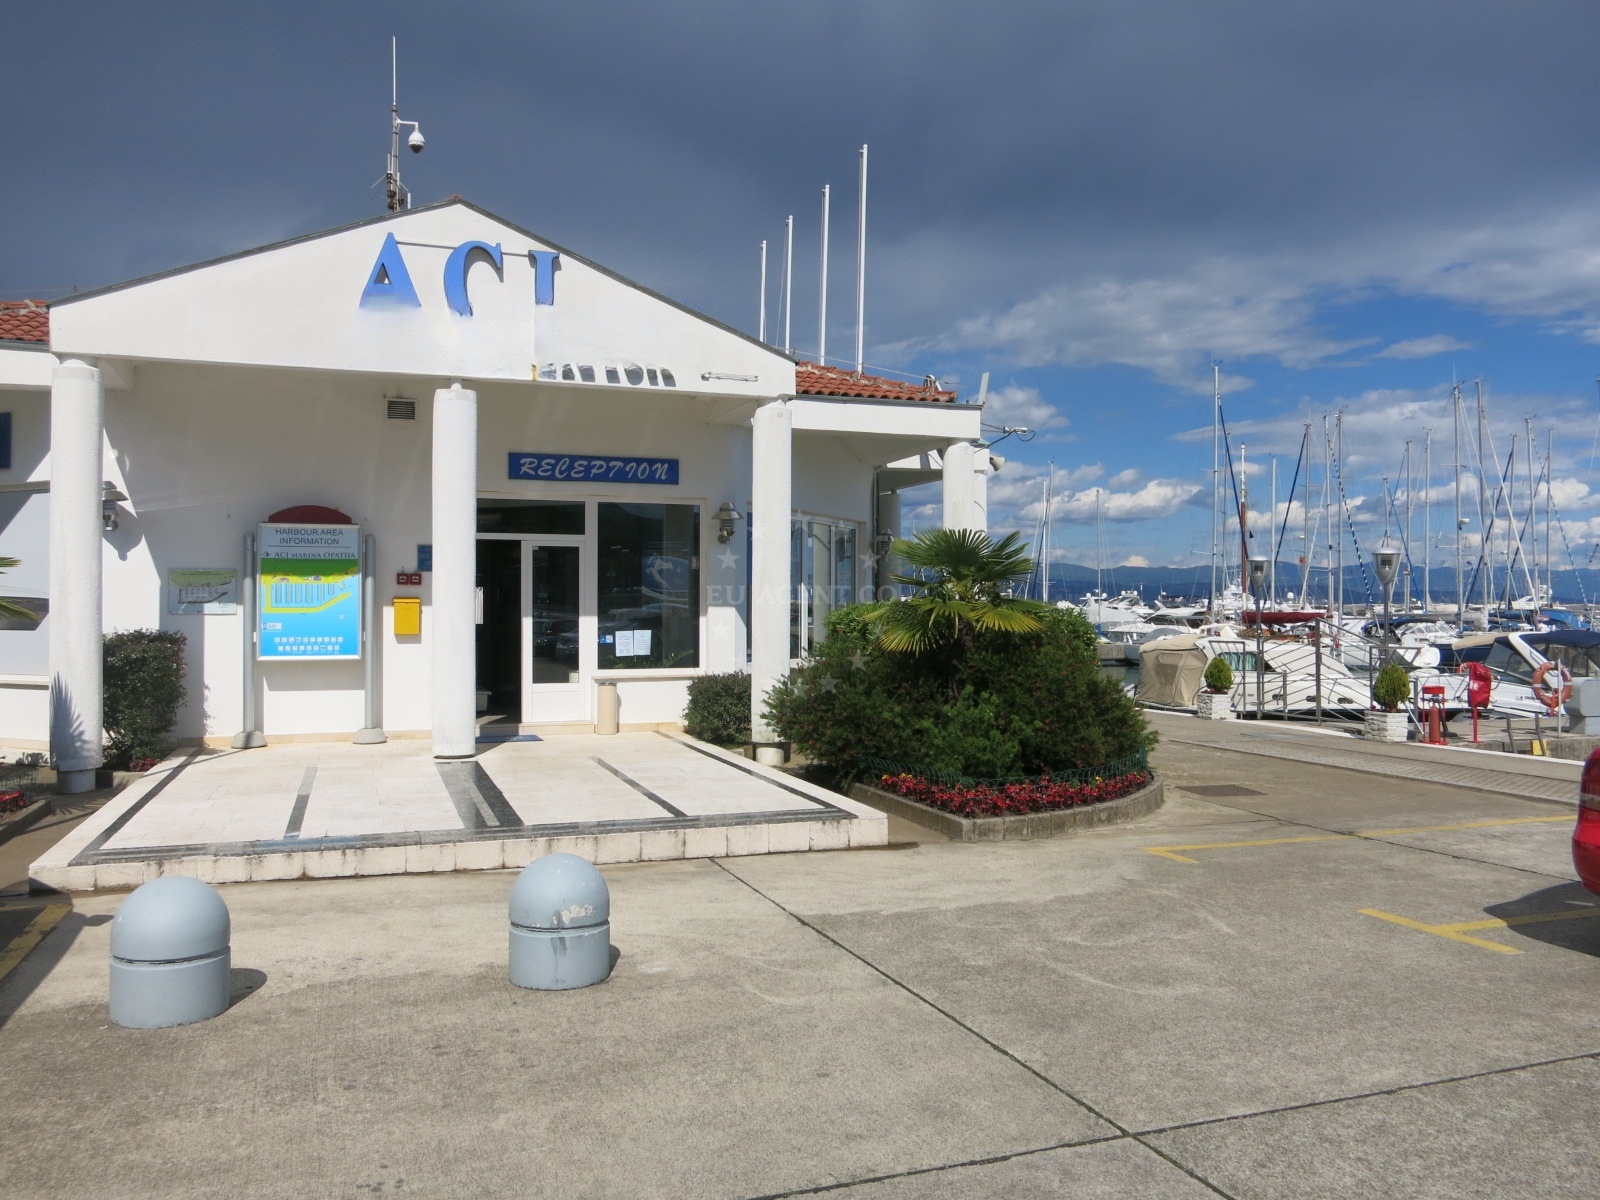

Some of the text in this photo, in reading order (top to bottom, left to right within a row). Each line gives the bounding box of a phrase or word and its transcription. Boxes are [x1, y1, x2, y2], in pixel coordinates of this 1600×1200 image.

[359, 232, 560, 317] ACI
[519, 457, 669, 480] RECEPTION
[275, 528, 318, 536] HARBOUR
[279, 537, 340, 545] INFORMATION
